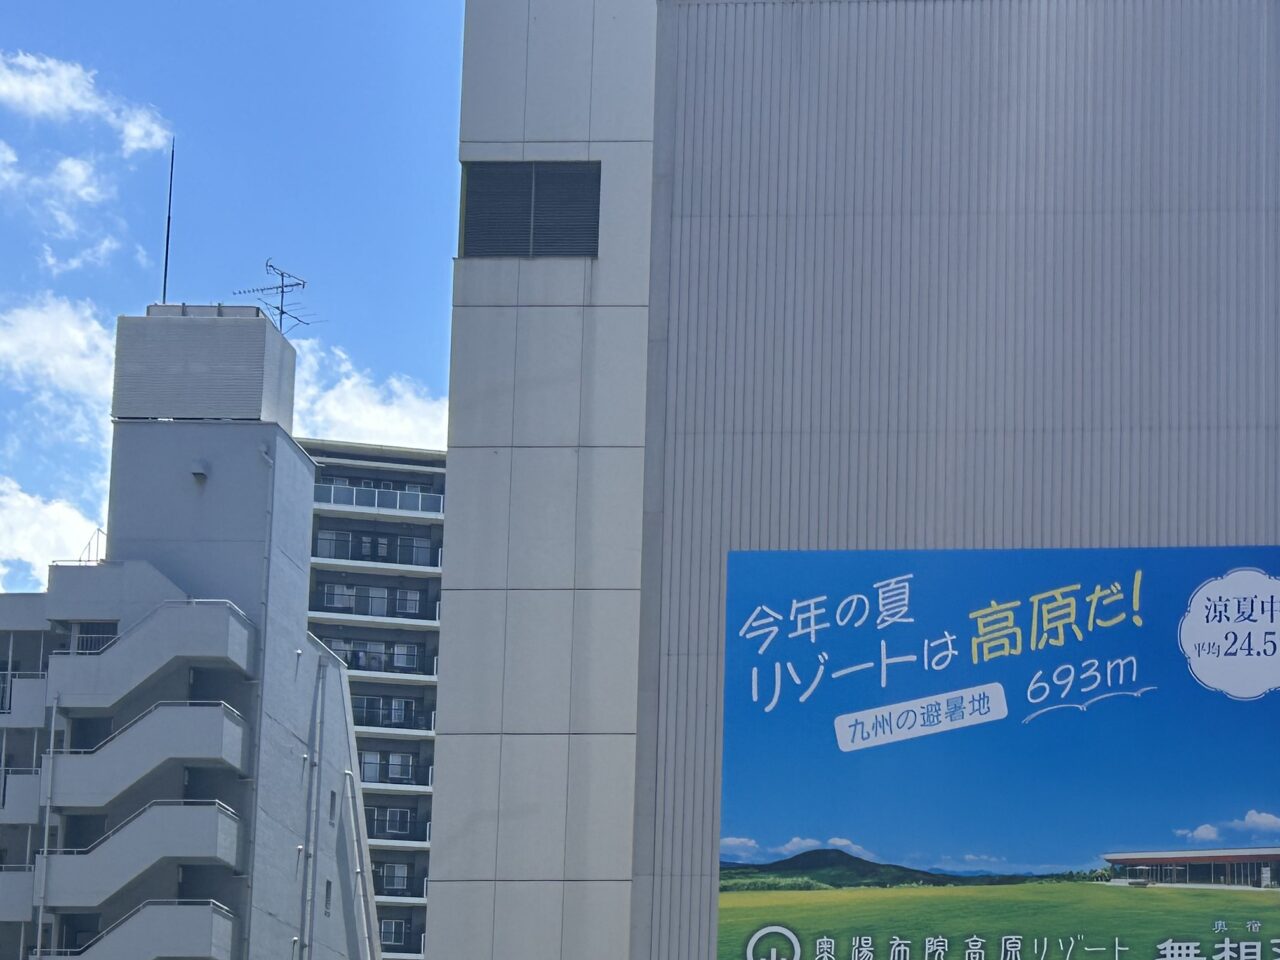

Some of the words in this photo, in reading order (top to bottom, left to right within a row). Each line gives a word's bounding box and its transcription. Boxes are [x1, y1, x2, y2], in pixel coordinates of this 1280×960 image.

[739, 573, 914, 654] 今年の夏
[1026, 657, 1138, 704] 693m
[848, 692, 991, 744] 九州の避暑地
